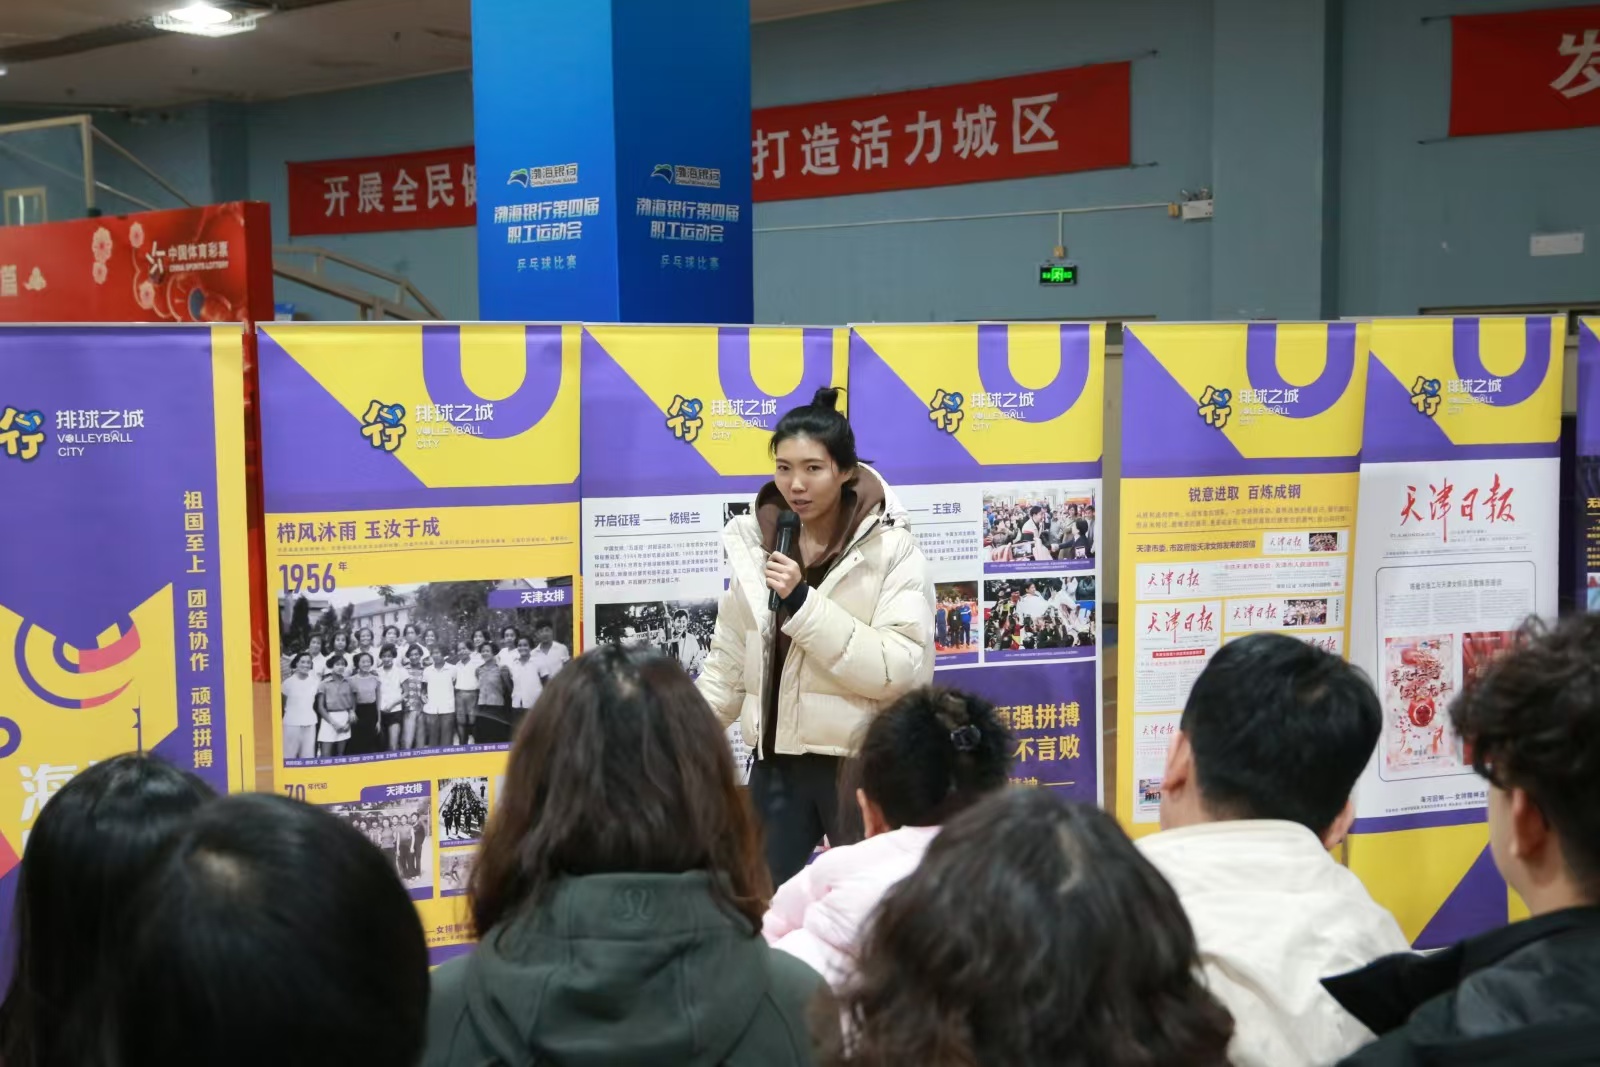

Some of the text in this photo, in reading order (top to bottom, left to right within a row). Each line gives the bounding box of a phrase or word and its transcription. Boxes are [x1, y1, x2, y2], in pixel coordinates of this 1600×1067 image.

[752, 93, 1059, 181] 打造活力城区
[531, 163, 578, 180] 渤海银行
[676, 166, 720, 181] 渤海银行
[494, 197, 599, 224] 渤海银行第四届
[636, 197, 740, 222] 渤海银行第四届
[507, 221, 582, 244] 职工运动会
[650, 221, 724, 242] 职工运动会
[168, 241, 229, 261] 中国体育彩票
[517, 254, 577, 272] 乒乓球比赛
[660, 254, 719, 271] 乒乓球比赛
[1448, 379, 1502, 393] 排球之城
[971, 392, 1035, 408] 排球之城
[1240, 388, 1299, 404] 排球之城
[416, 403, 494, 422] 排球之城
[710, 399, 777, 416] 排球之城
[56, 409, 144, 430] 排球之城
[57, 431, 133, 444] VOLLEYBALL
[58, 446, 85, 457] CITY
[1188, 484, 1301, 502] 锐意进取 百炼成钢
[932, 502, 962, 515] 王宝泉
[594, 513, 640, 527] 开启征程
[669, 512, 701, 525] 杨锡兰
[183, 491, 206, 573] 祖国至上
[276, 516, 441, 543] 栉风沐雨 玉汝于成
[278, 562, 347, 595] 1956 年
[520, 590, 564, 604] 天津女排
[187, 589, 209, 672] 团结协作
[190, 687, 213, 769] 顽强拼搏
[386, 784, 423, 798] 天津女排
